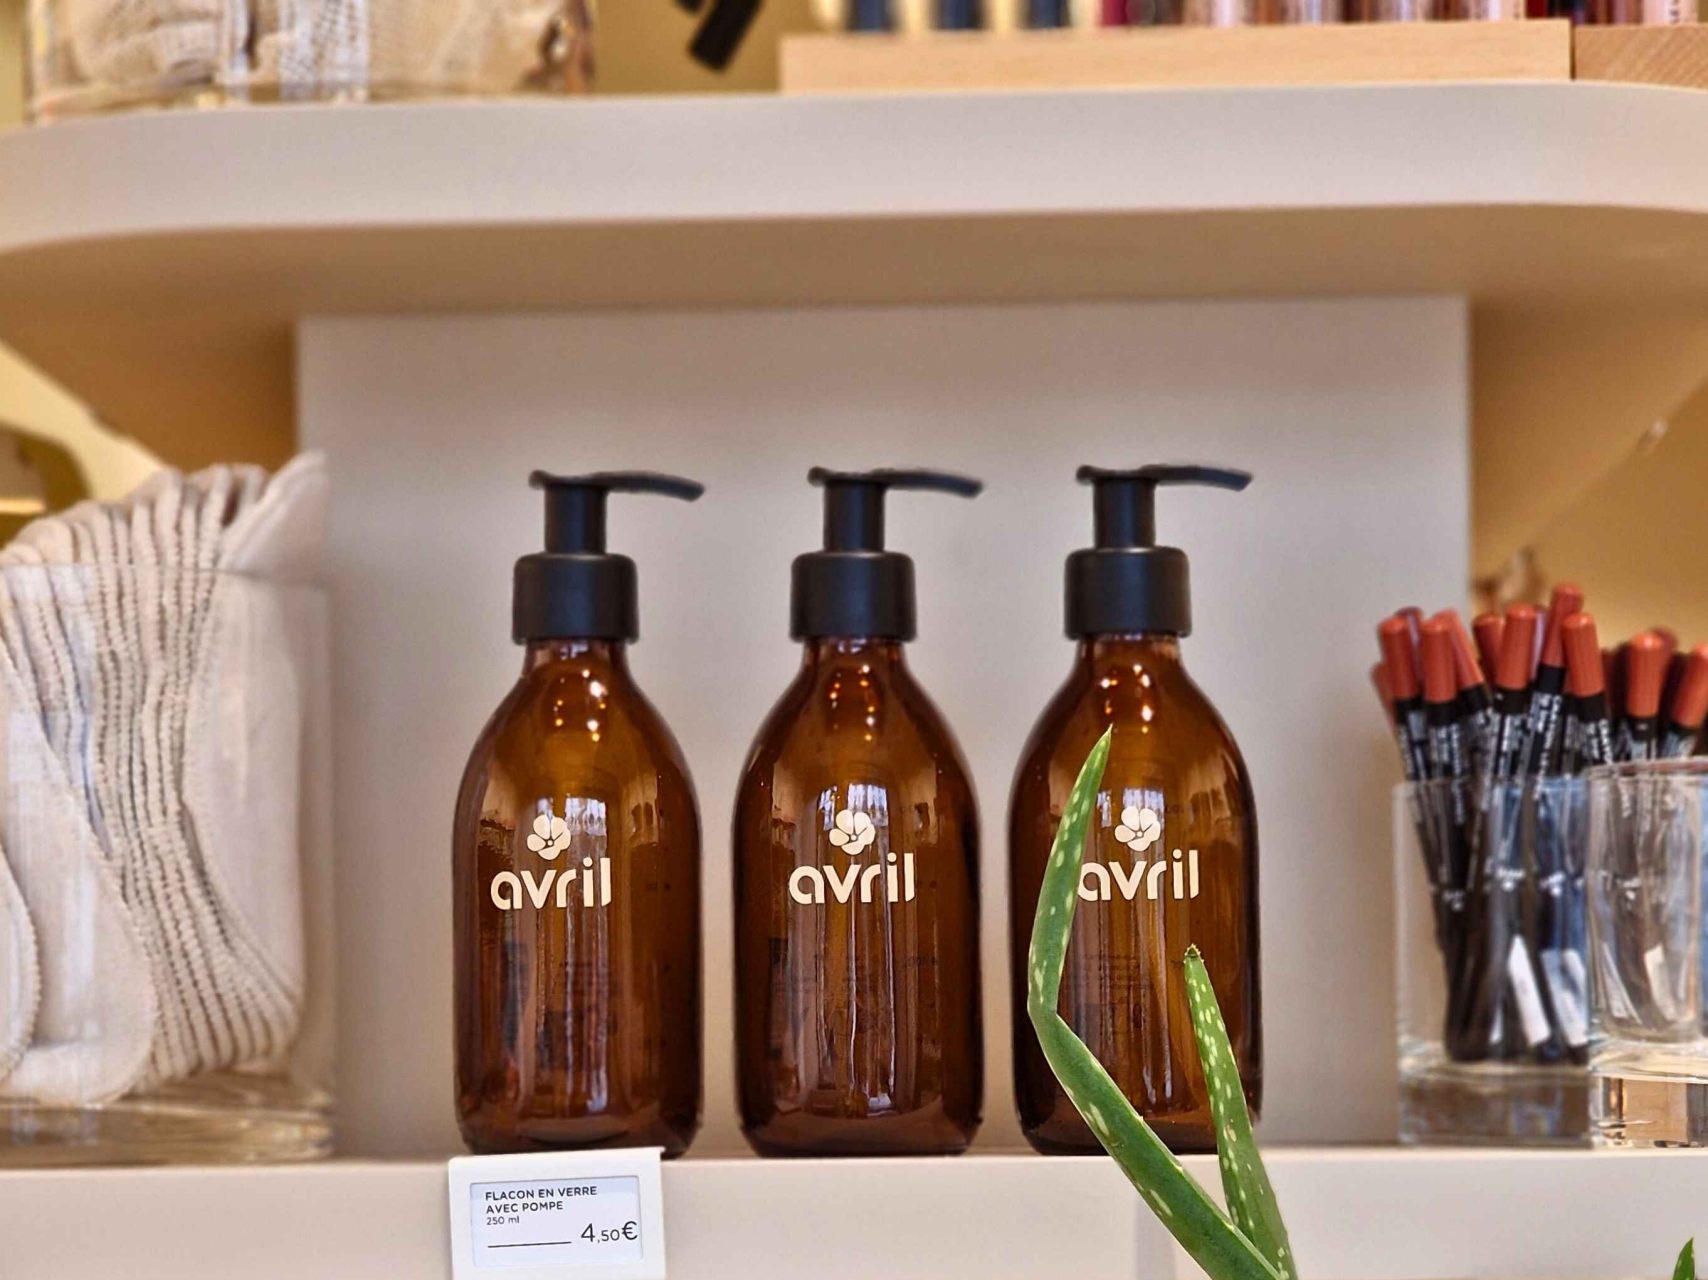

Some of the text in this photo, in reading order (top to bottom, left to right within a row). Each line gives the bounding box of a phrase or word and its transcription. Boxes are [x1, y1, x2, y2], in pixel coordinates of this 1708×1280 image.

[490, 857, 611, 911] avril
[788, 852, 915, 905] avril
[1077, 848, 1199, 902] avril
[485, 1185, 597, 1201] FLACON EN VERRE
[486, 1200, 564, 1214] AVEC POMPE
[486, 1215, 520, 1226] 250 ml
